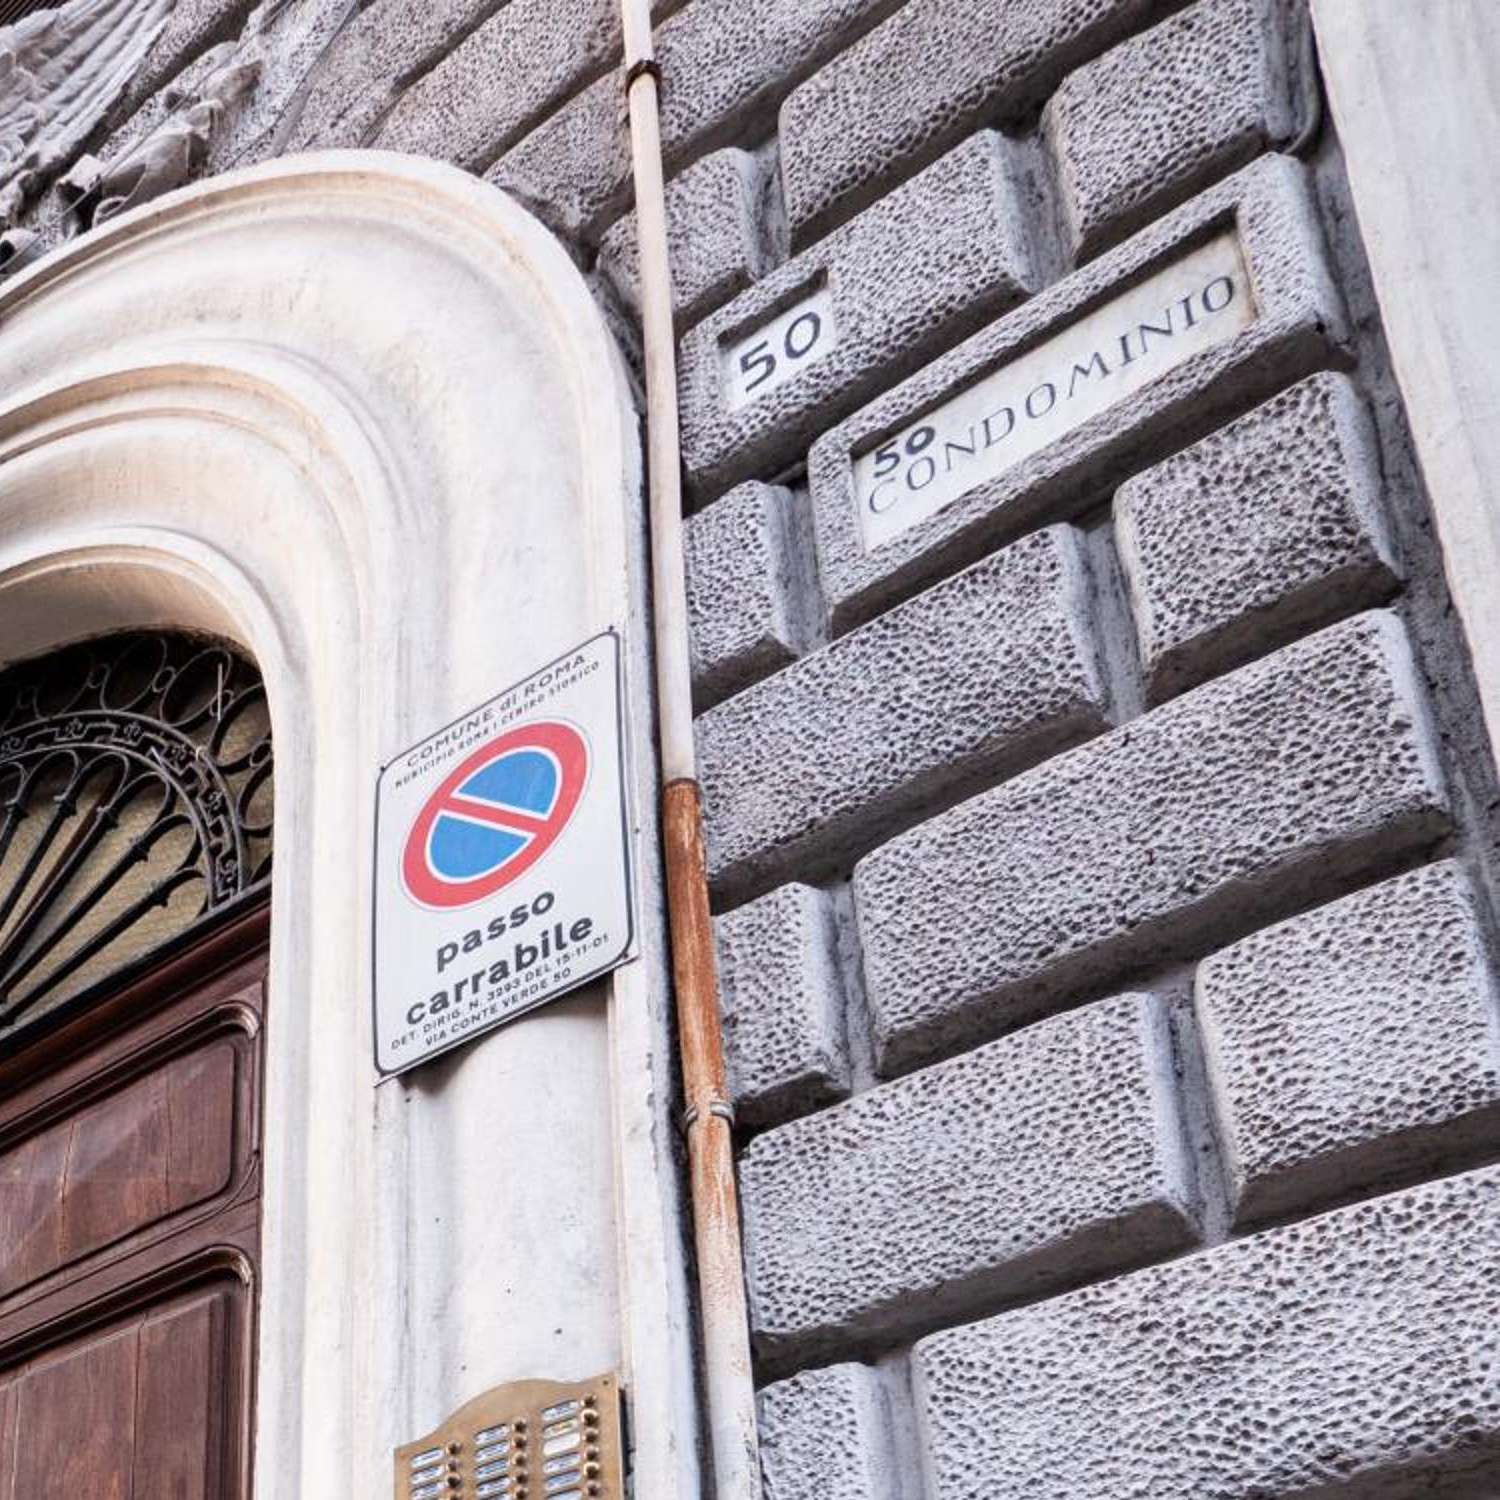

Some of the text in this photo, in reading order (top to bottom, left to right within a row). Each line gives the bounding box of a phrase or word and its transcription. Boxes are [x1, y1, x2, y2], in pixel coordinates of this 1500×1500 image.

[737, 310, 822, 393] 50
[868, 274, 1236, 515] CONDOMINIO
[873, 425, 936, 479] 50
[407, 654, 586, 768] COMUNE di ROMA
[458, 726, 490, 751] ROMA
[501, 692, 546, 725] CENTRO
[548, 660, 600, 697] STORICO
[406, 916, 593, 1026] carrabile
[437, 891, 555, 973] passo
[425, 967, 572, 1047] VIA CONTE VERDE 50
[487, 978, 521, 1002] 3293
[525, 963, 551, 983] DEL
